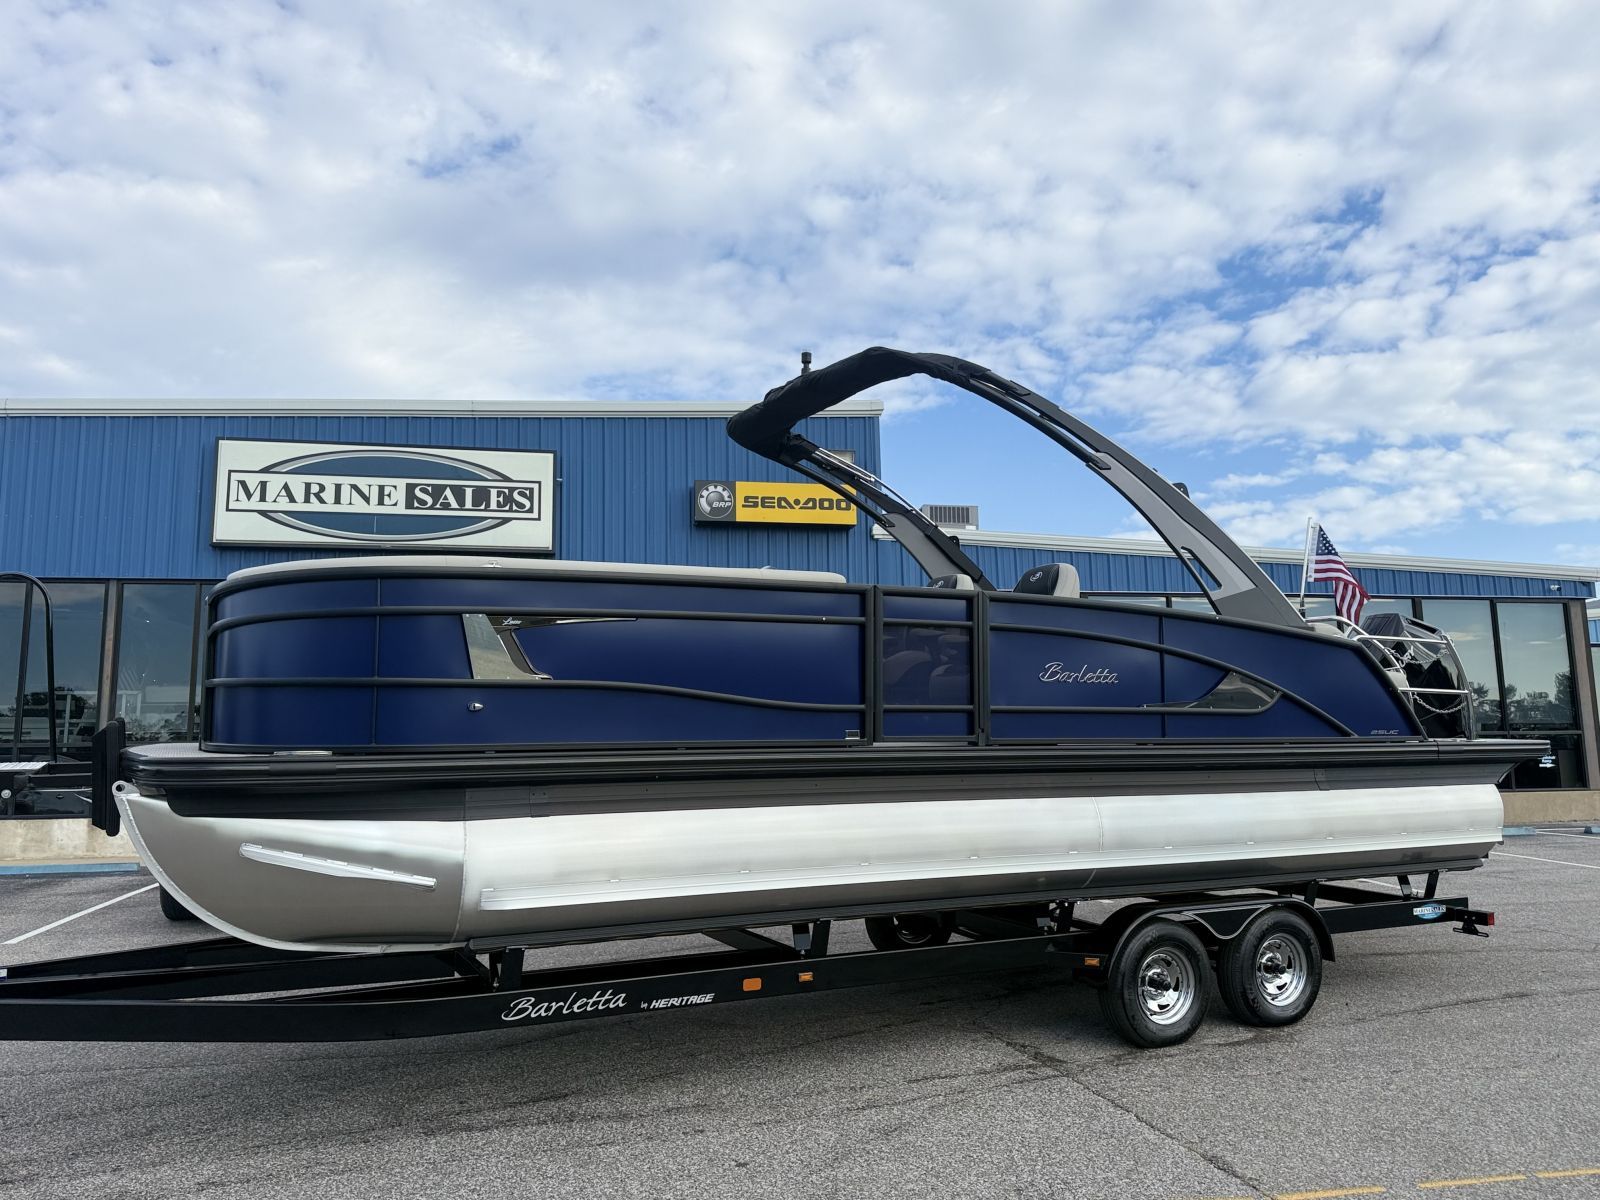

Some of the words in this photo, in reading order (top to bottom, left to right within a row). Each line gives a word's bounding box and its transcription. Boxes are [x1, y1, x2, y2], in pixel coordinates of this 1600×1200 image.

[234, 479, 399, 507] MARINE
[413, 485, 532, 512] SALES
[712, 501, 732, 509] BRP
[1038, 661, 1119, 683] Barletta
[501, 989, 627, 1021] Barletta
[650, 993, 715, 1009] HERITAGE
